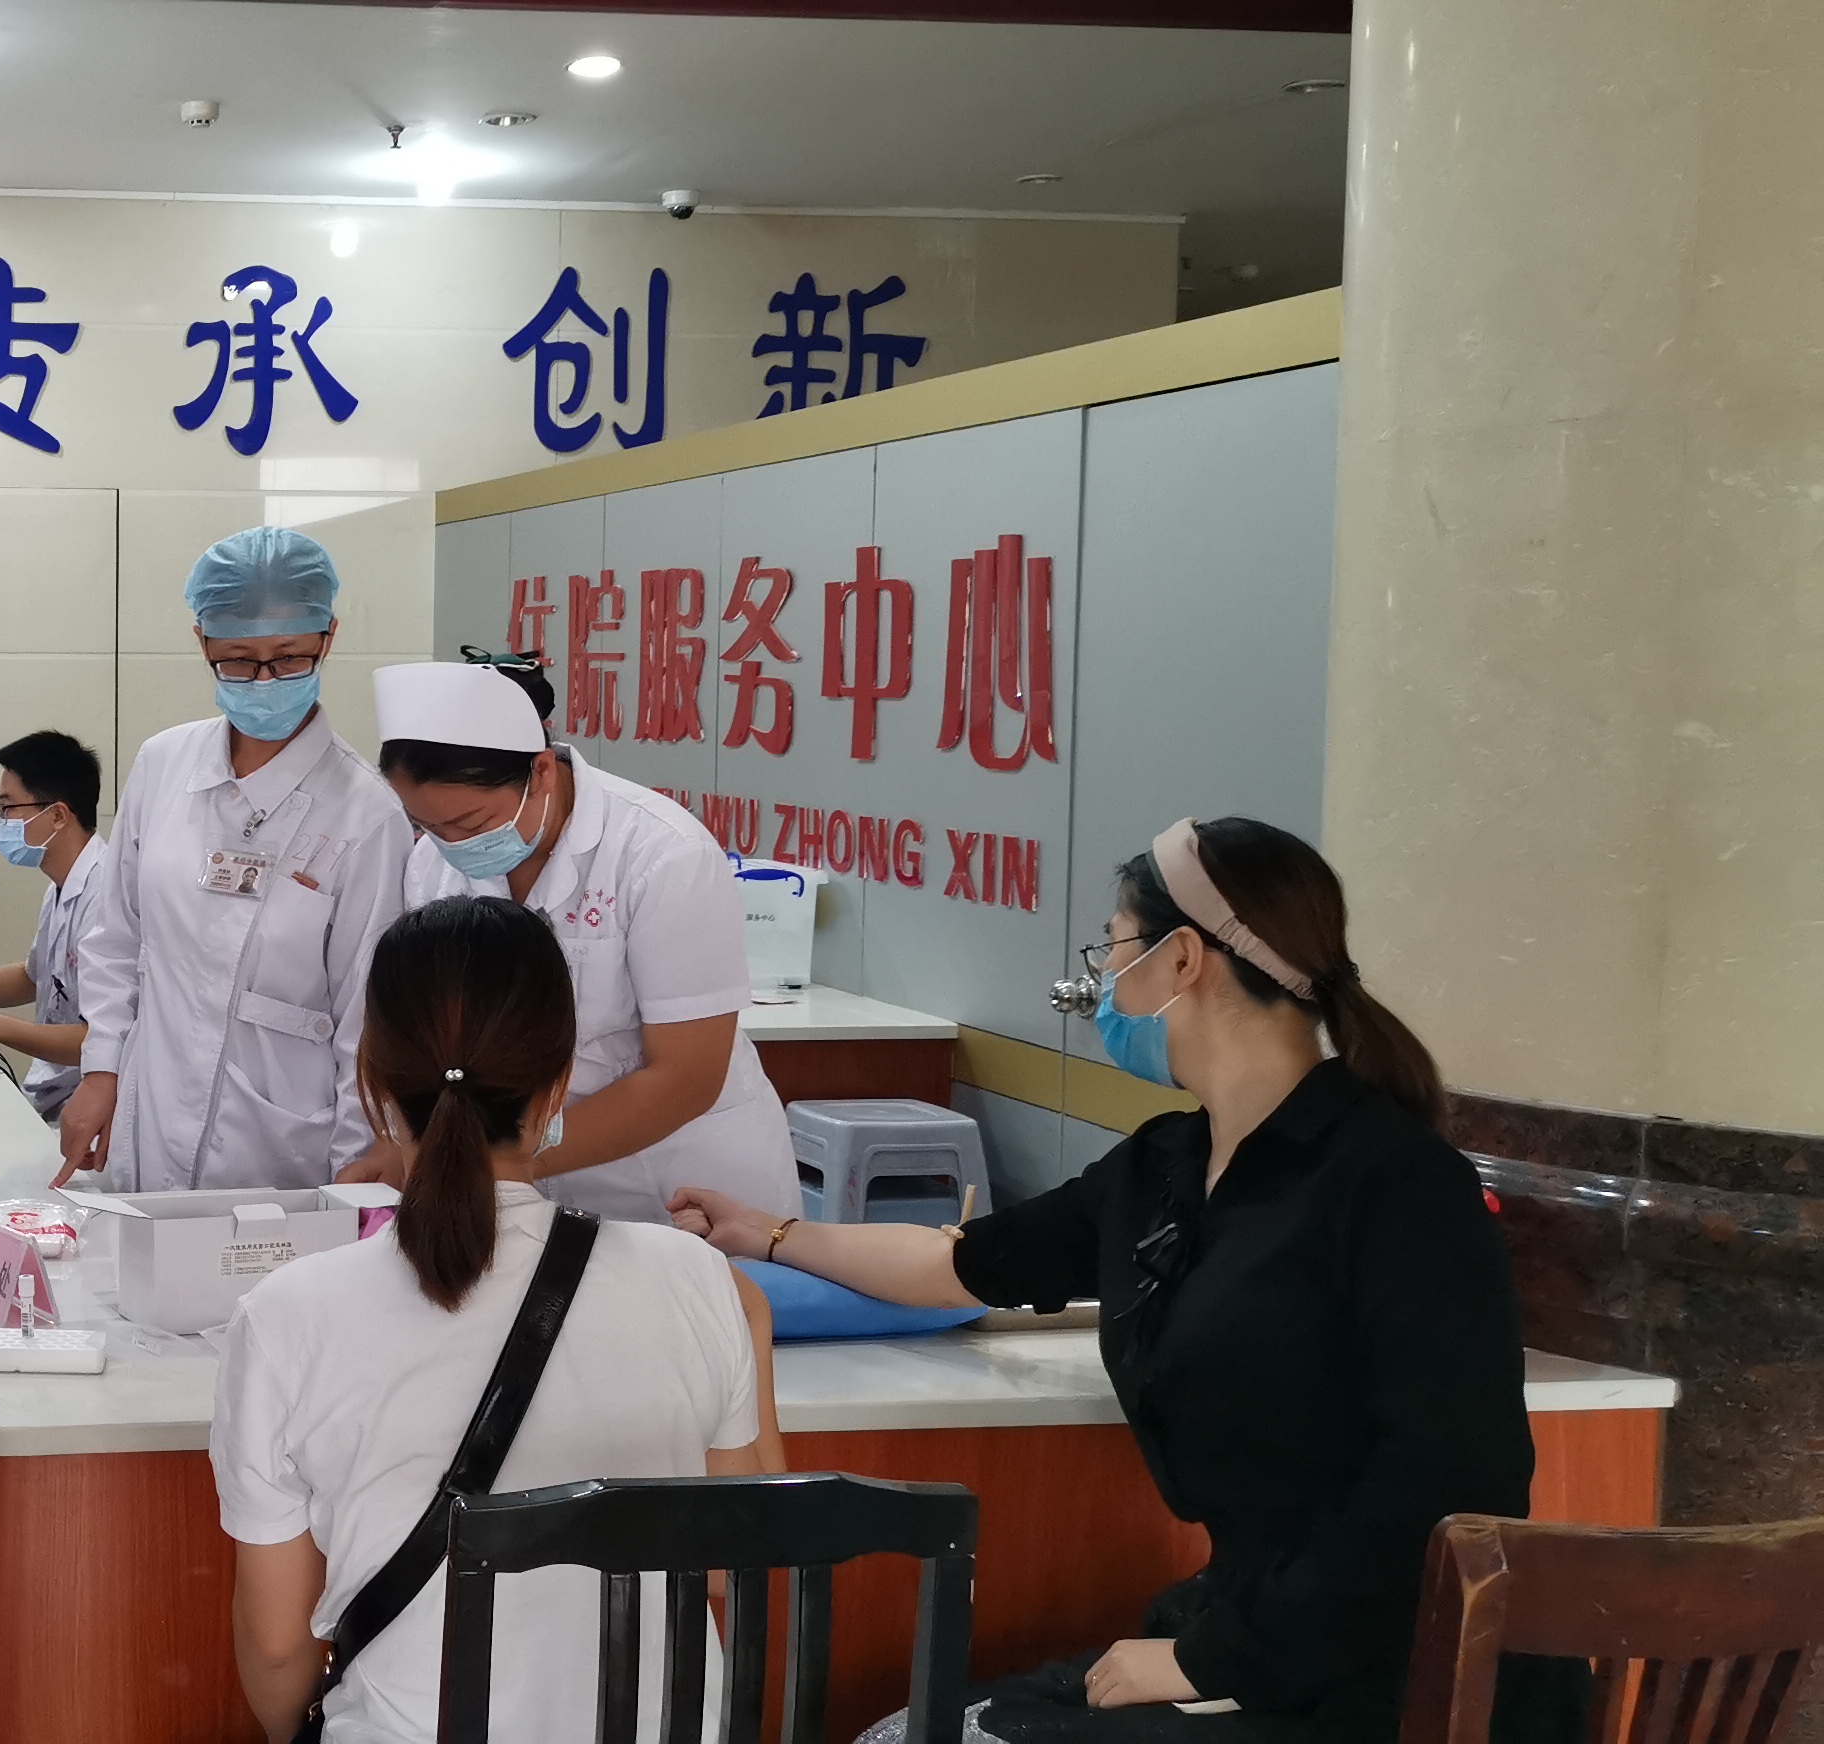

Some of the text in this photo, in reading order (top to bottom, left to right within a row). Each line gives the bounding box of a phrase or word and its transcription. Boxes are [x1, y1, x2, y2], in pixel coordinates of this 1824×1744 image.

[506, 533, 1058, 772] 住院服务中心
[702, 793, 1041, 913] WU ZHONG XIN
